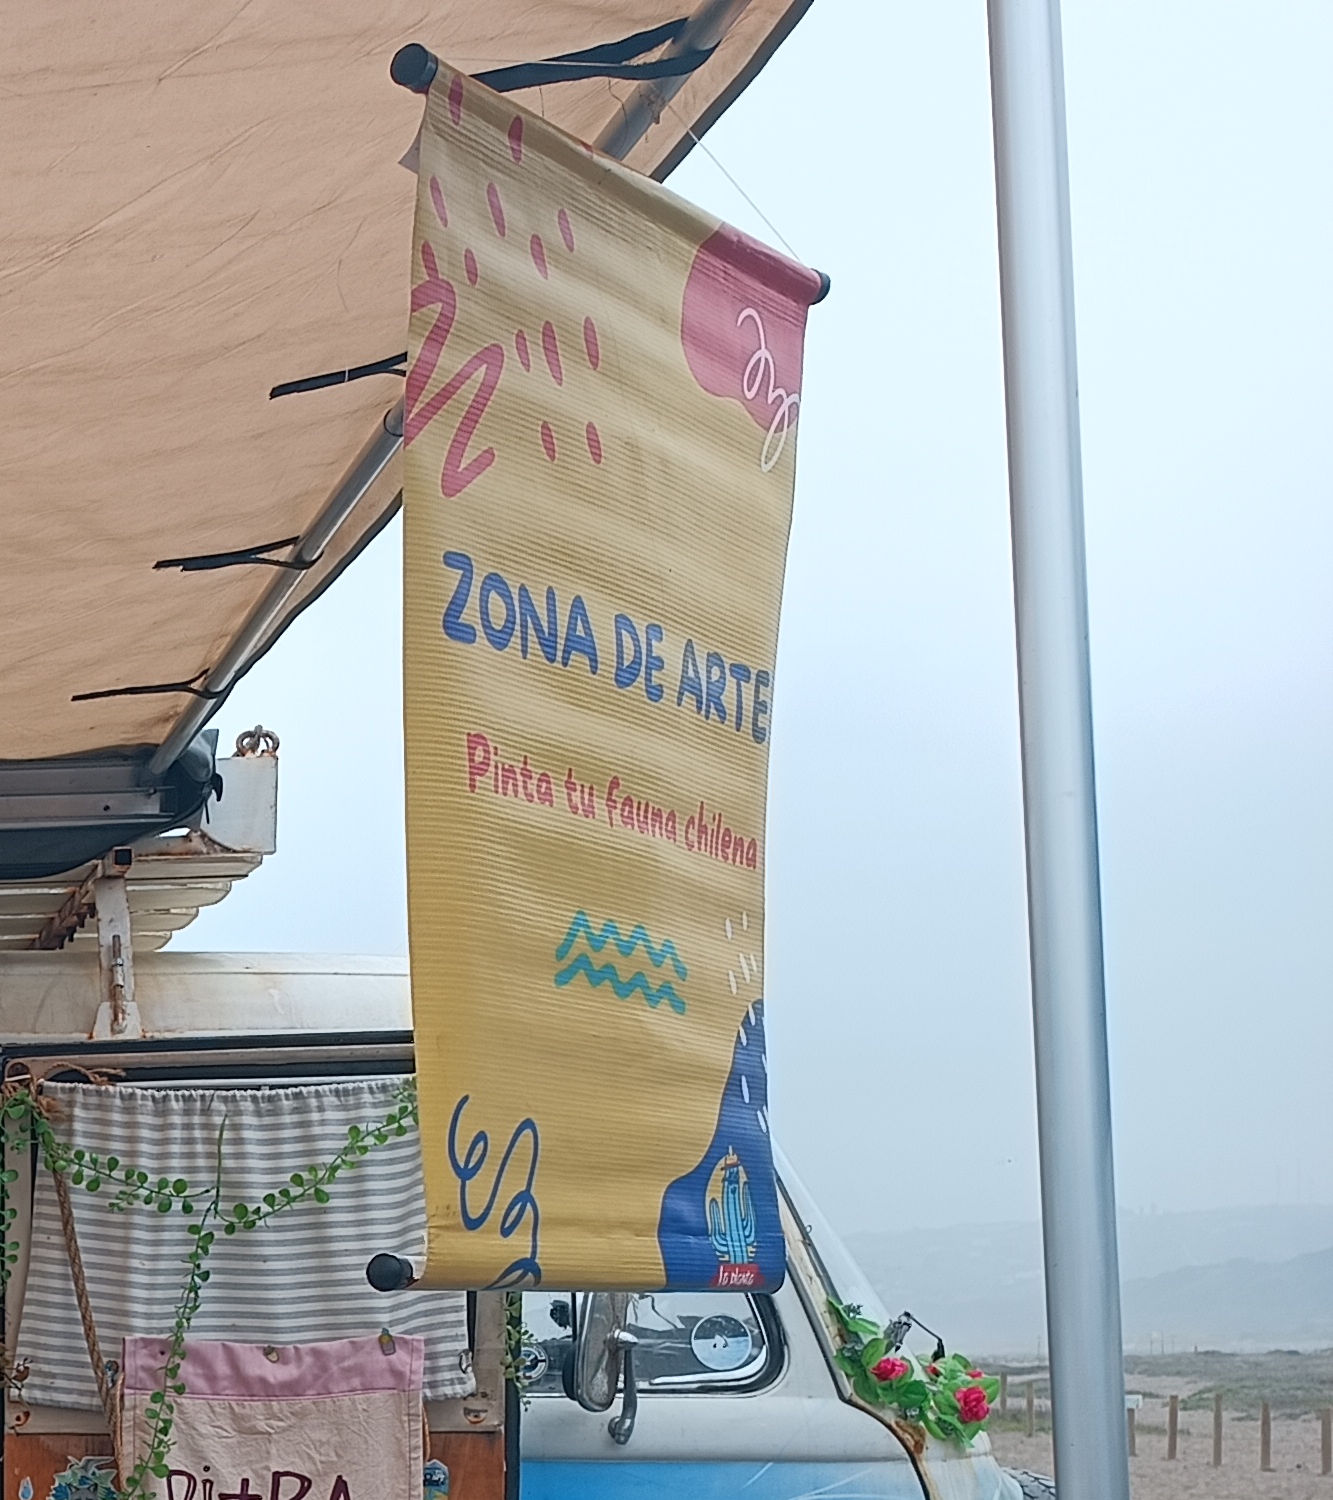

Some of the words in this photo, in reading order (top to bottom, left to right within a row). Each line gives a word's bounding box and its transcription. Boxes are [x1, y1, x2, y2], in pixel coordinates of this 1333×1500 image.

[441, 550, 599, 676] ZONA
[613, 613, 665, 703] DE
[677, 638, 771, 744] ARTE
[464, 732, 555, 809] Pinta
[563, 766, 597, 818] tu
[604, 775, 678, 845] fauna
[684, 800, 758, 871] chilena
